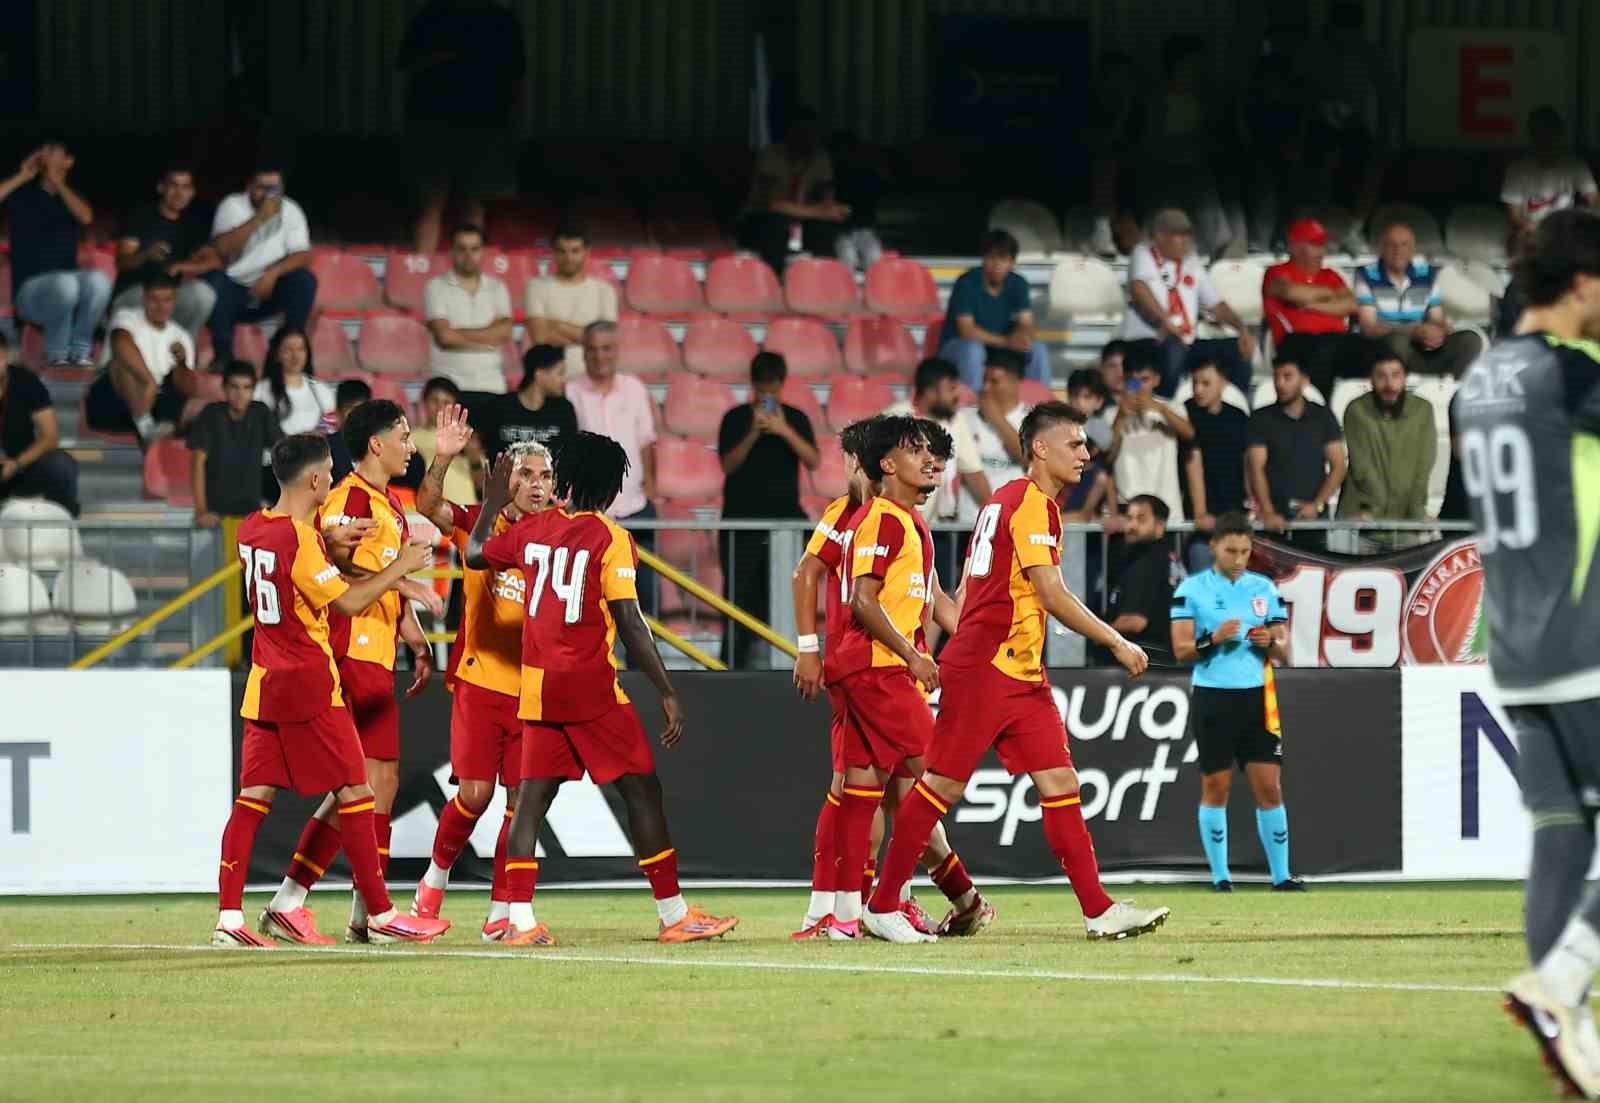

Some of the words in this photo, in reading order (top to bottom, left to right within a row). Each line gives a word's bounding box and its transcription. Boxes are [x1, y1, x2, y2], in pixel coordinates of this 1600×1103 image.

[1459, 45, 1516, 134] E
[1461, 424, 1537, 554] 99
[238, 543, 281, 625] 76
[524, 542, 591, 624] 74
[1279, 565, 1403, 668] 19
[0, 741, 51, 834] T
[954, 743, 1178, 846] sport
